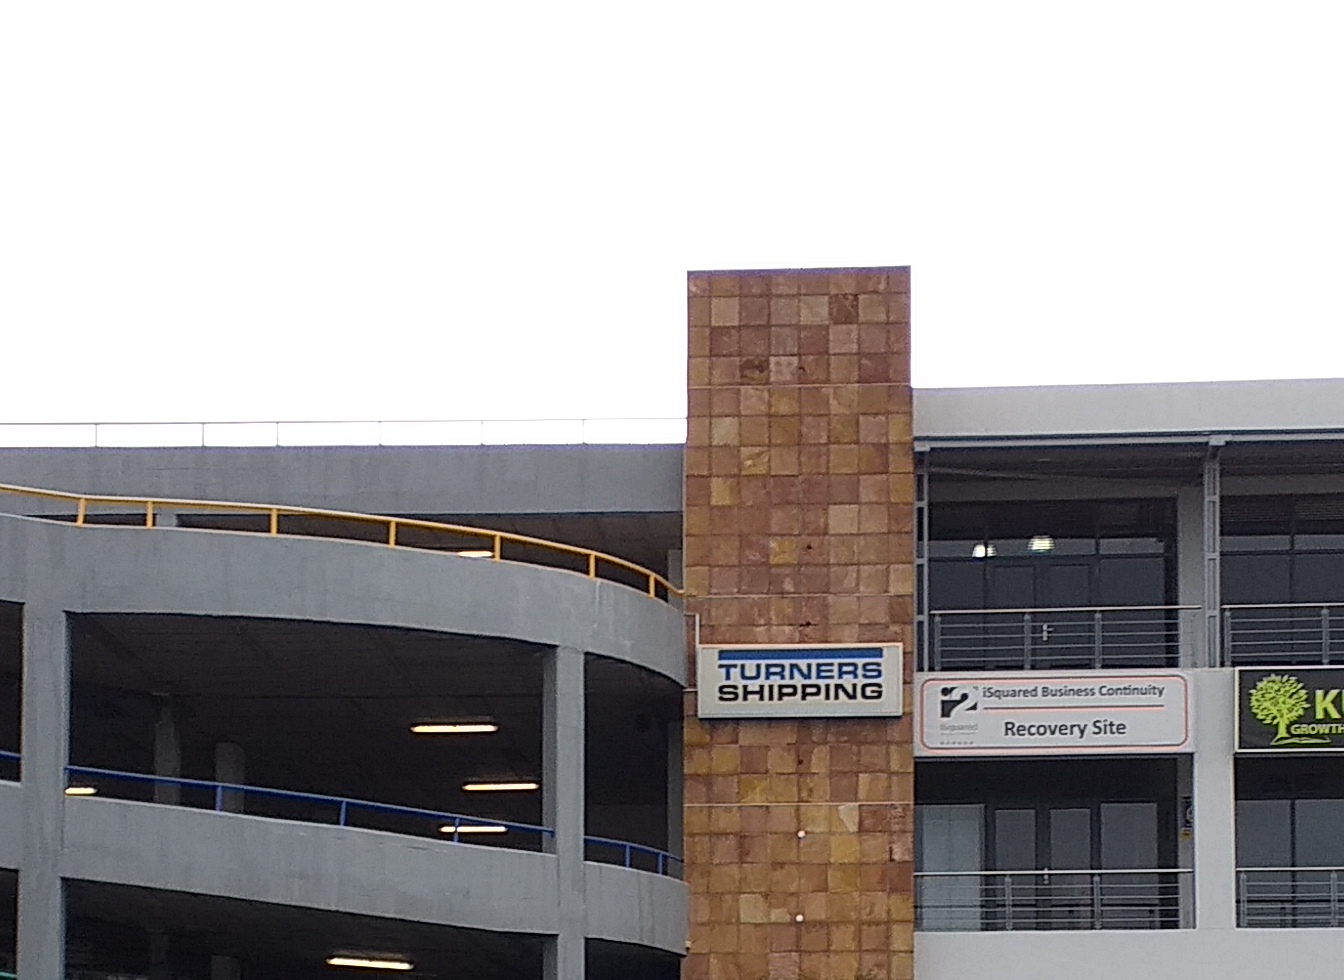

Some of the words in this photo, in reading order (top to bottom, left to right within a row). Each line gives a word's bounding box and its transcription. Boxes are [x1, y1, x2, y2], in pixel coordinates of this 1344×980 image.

[718, 662, 882, 681] TURNERS
[718, 683, 884, 702] SHIPPING
[983, 687, 1038, 700] iSquared
[1041, 685, 1096, 698] Business
[1099, 684, 1165, 698] Continuity
[1004, 721, 1088, 739] Recovery
[1092, 719, 1127, 735] Site
